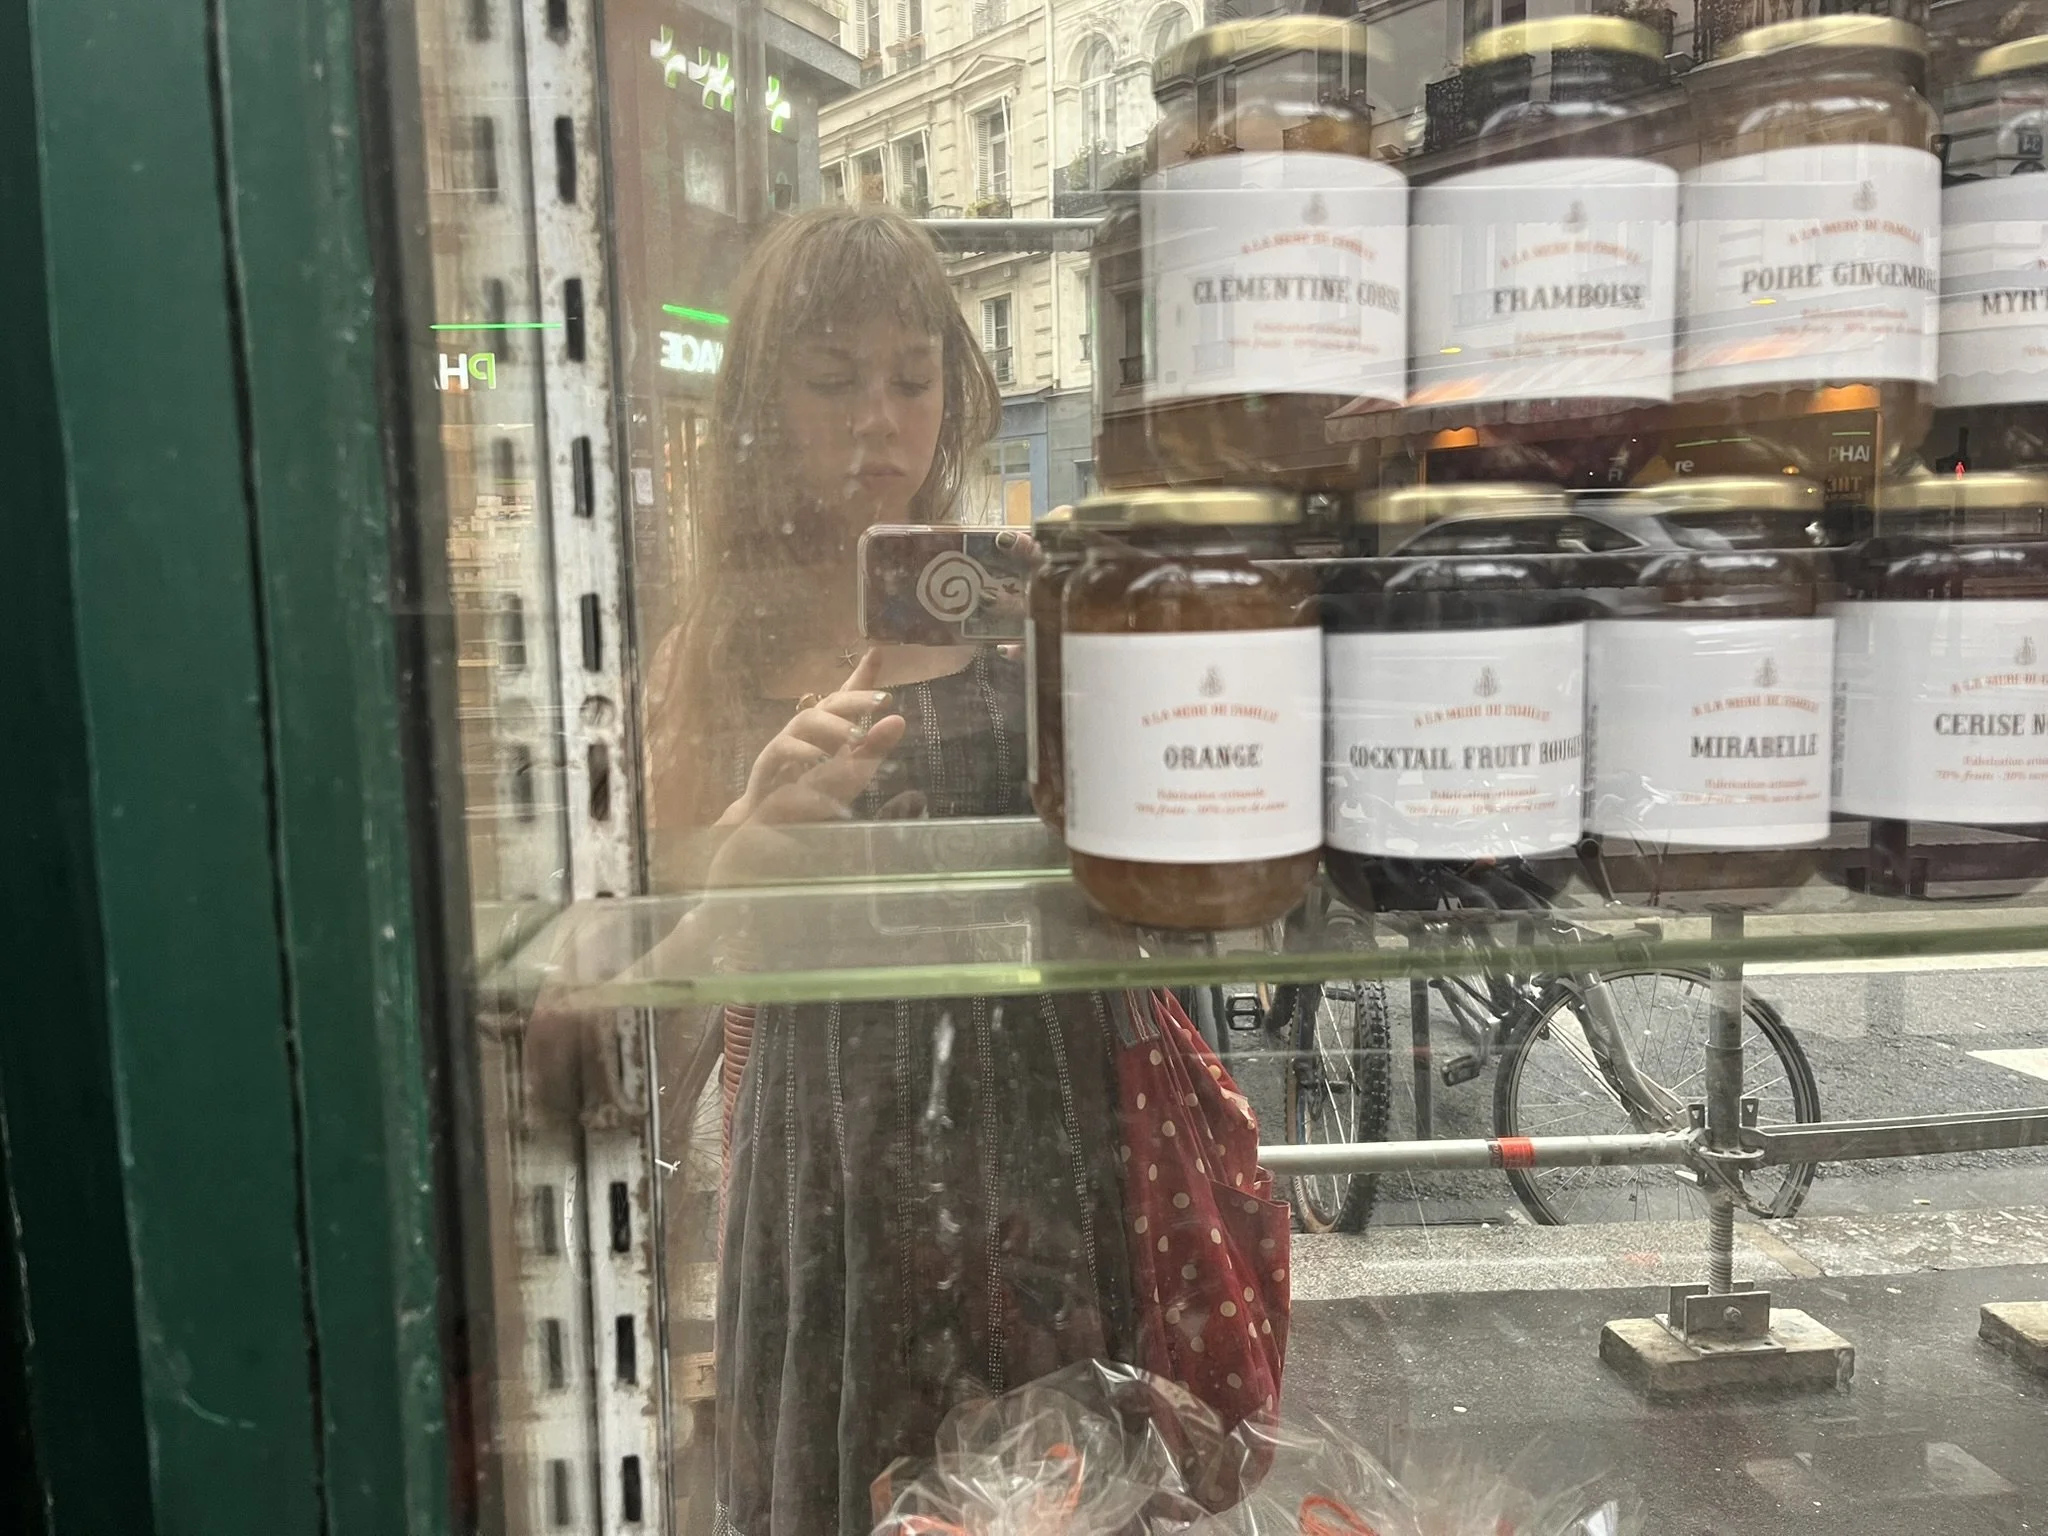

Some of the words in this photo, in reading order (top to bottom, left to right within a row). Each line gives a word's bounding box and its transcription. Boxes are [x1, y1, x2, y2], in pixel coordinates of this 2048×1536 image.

[1741, 264, 1823, 294] POIRE
[1493, 282, 1645, 314] FRAMBOISE
[1935, 713, 2025, 737] CERISE
[2031, 713, 2048, 737] N
[1164, 743, 1264, 771] ORANGE
[1350, 741, 1452, 771] COCKTAIL
[1463, 742, 1533, 770] FRUIT
[1691, 733, 1818, 759] MIRABELLE
